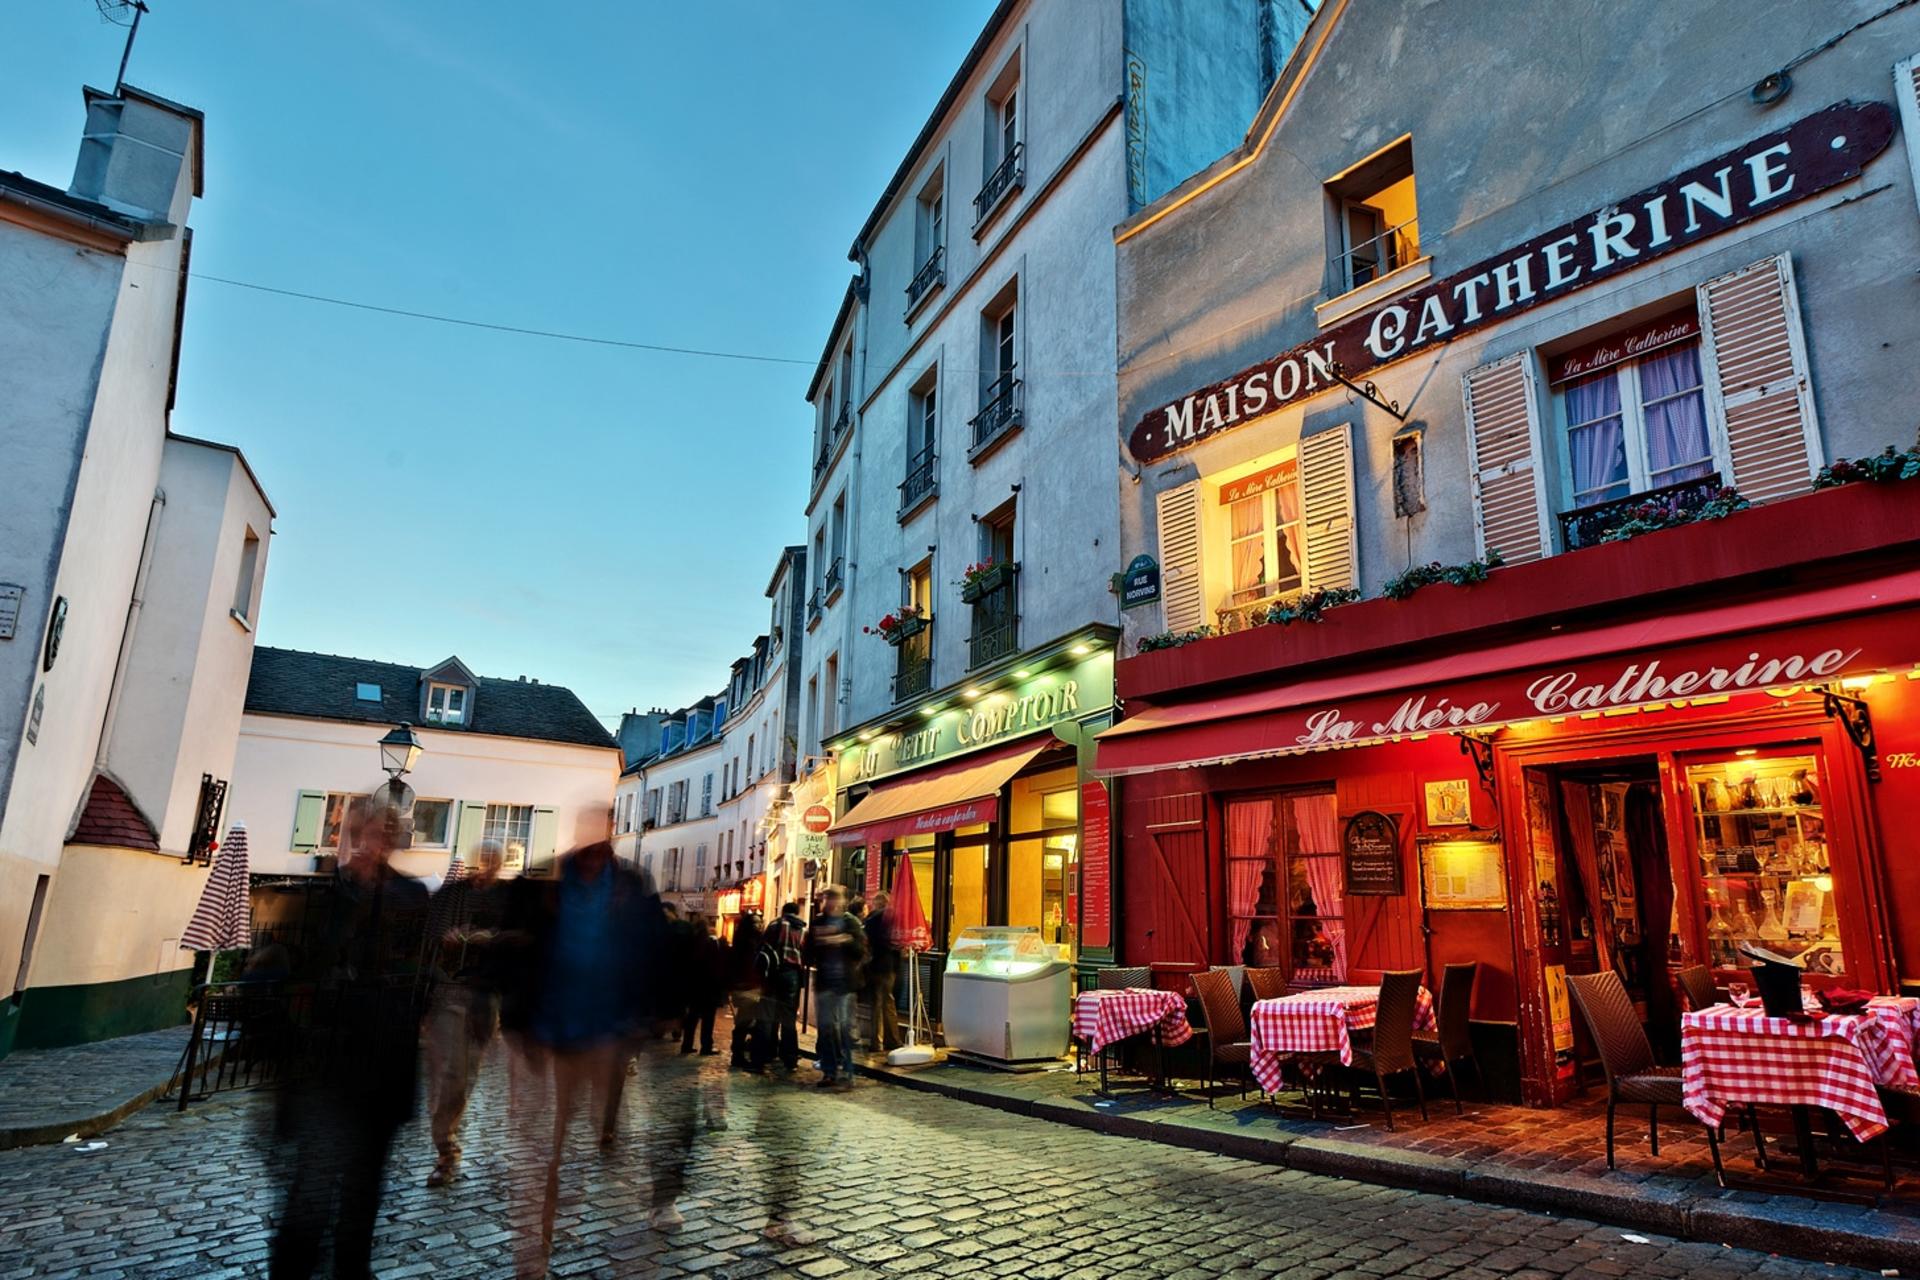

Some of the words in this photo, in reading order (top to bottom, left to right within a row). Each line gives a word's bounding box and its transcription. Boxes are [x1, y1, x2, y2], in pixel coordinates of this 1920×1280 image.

[1163, 339, 1336, 447] MAISON
[1364, 141, 1796, 359] CATHERINE
[1564, 359, 1581, 376] La
[1586, 348, 1620, 368] Mère
[1624, 323, 1689, 353] Catherine
[1228, 488, 1239, 501] La
[1127, 586, 1155, 600] NORVINS
[1134, 575, 1148, 586] RUE
[890, 727, 940, 762] PETIT
[957, 681, 1078, 744] COMPTOIR
[1296, 709, 1363, 746] La
[1526, 647, 1862, 713] Catherine
